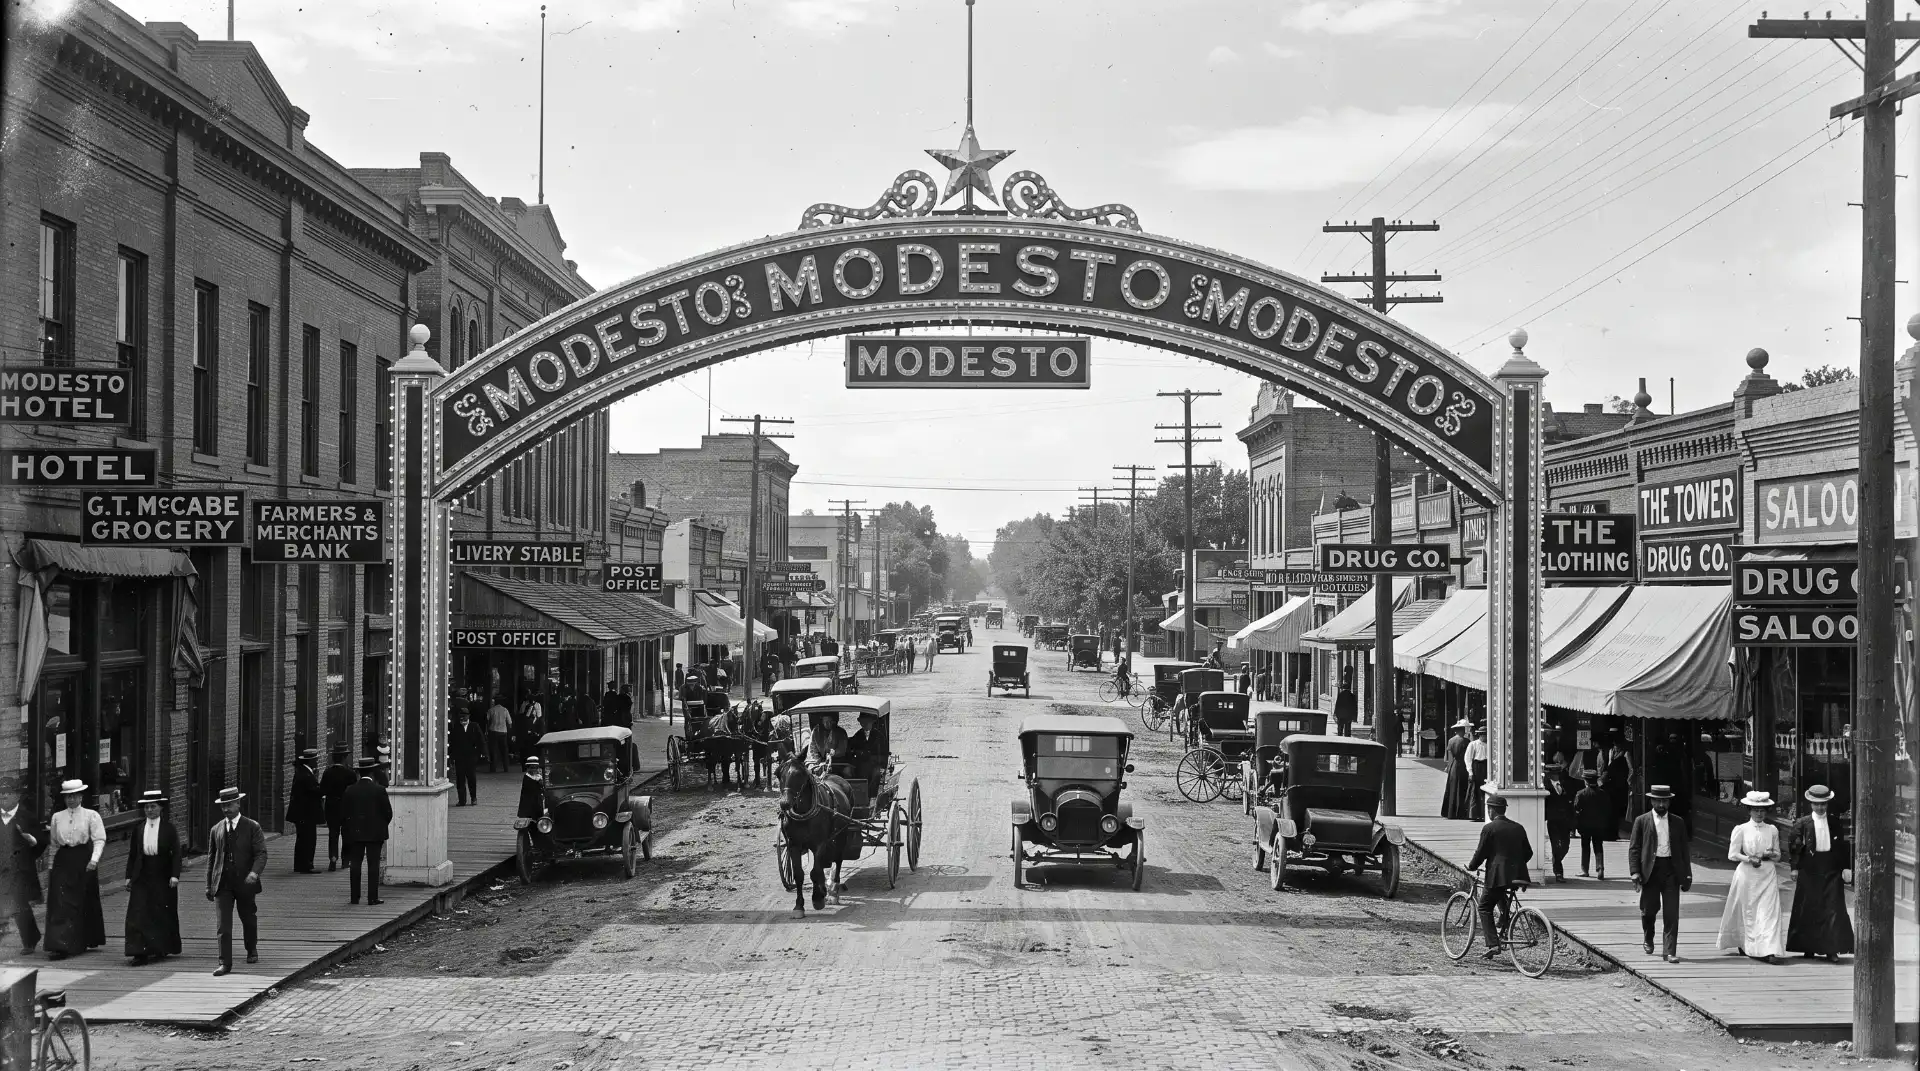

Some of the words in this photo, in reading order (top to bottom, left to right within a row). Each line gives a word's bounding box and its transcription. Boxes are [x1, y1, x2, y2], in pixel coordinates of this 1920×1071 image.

[765, 243, 1171, 311] MODESTO
[482, 282, 732, 421] MODESTO
[1201, 278, 1445, 416] MODESTO
[857, 346, 1079, 377] MODESTO
[1, 372, 125, 394] MODESTO
[1, 395, 115, 419] HOTEL
[11, 455, 146, 481] HOTEL
[1640, 488, 1670, 525] THE
[1673, 477, 1734, 524] TOWER
[1766, 479, 1902, 530] SALOO
[260, 506, 357, 522] FARMERS
[363, 508, 377, 522] &
[91, 520, 235, 540] GROCERY
[257, 525, 379, 541] MERCHANTS
[1552, 520, 1616, 545] THE
[284, 543, 350, 559] BANK
[456, 545, 514, 561] LIVERY
[520, 546, 583, 562] STABLE
[1329, 550, 1397, 568] DRUG
[1407, 550, 1446, 568] CO.
[1647, 545, 1692, 572] DRUG
[1699, 544, 1729, 572] CO.
[610, 566, 656, 577] POST
[1742, 568, 1840, 596] DRUG
[605, 579, 660, 590] OFFICE
[456, 632, 497, 645] POST
[502, 632, 557, 645] OFFICE
[1738, 615, 1859, 640] SALOO
